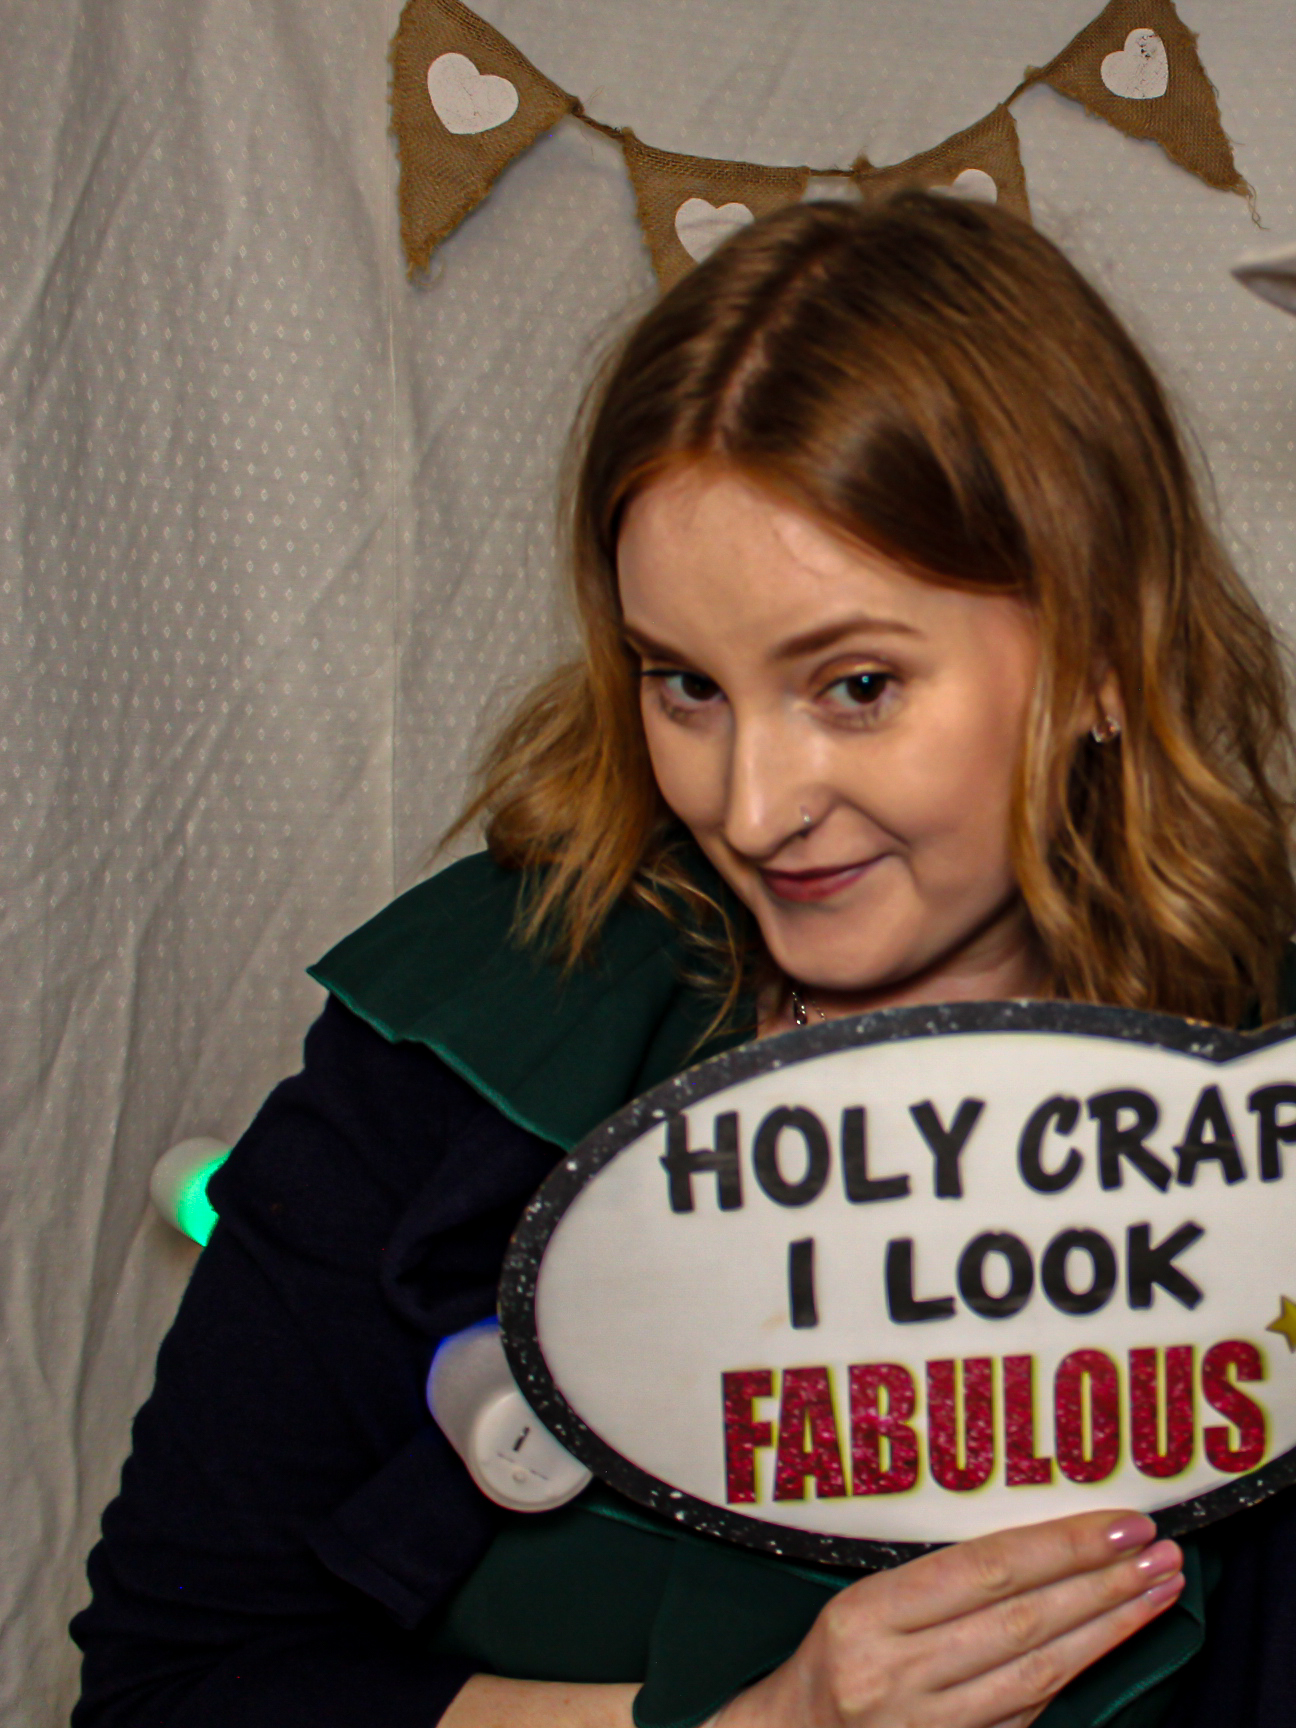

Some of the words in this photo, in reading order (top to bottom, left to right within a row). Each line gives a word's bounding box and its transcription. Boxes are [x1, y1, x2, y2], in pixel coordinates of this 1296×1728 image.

[660, 1097, 986, 1215] HOLY
[787, 1236, 819, 1331] I
[883, 1219, 1207, 1326] LOOK
[719, 1338, 1269, 1506] FABULOUS
